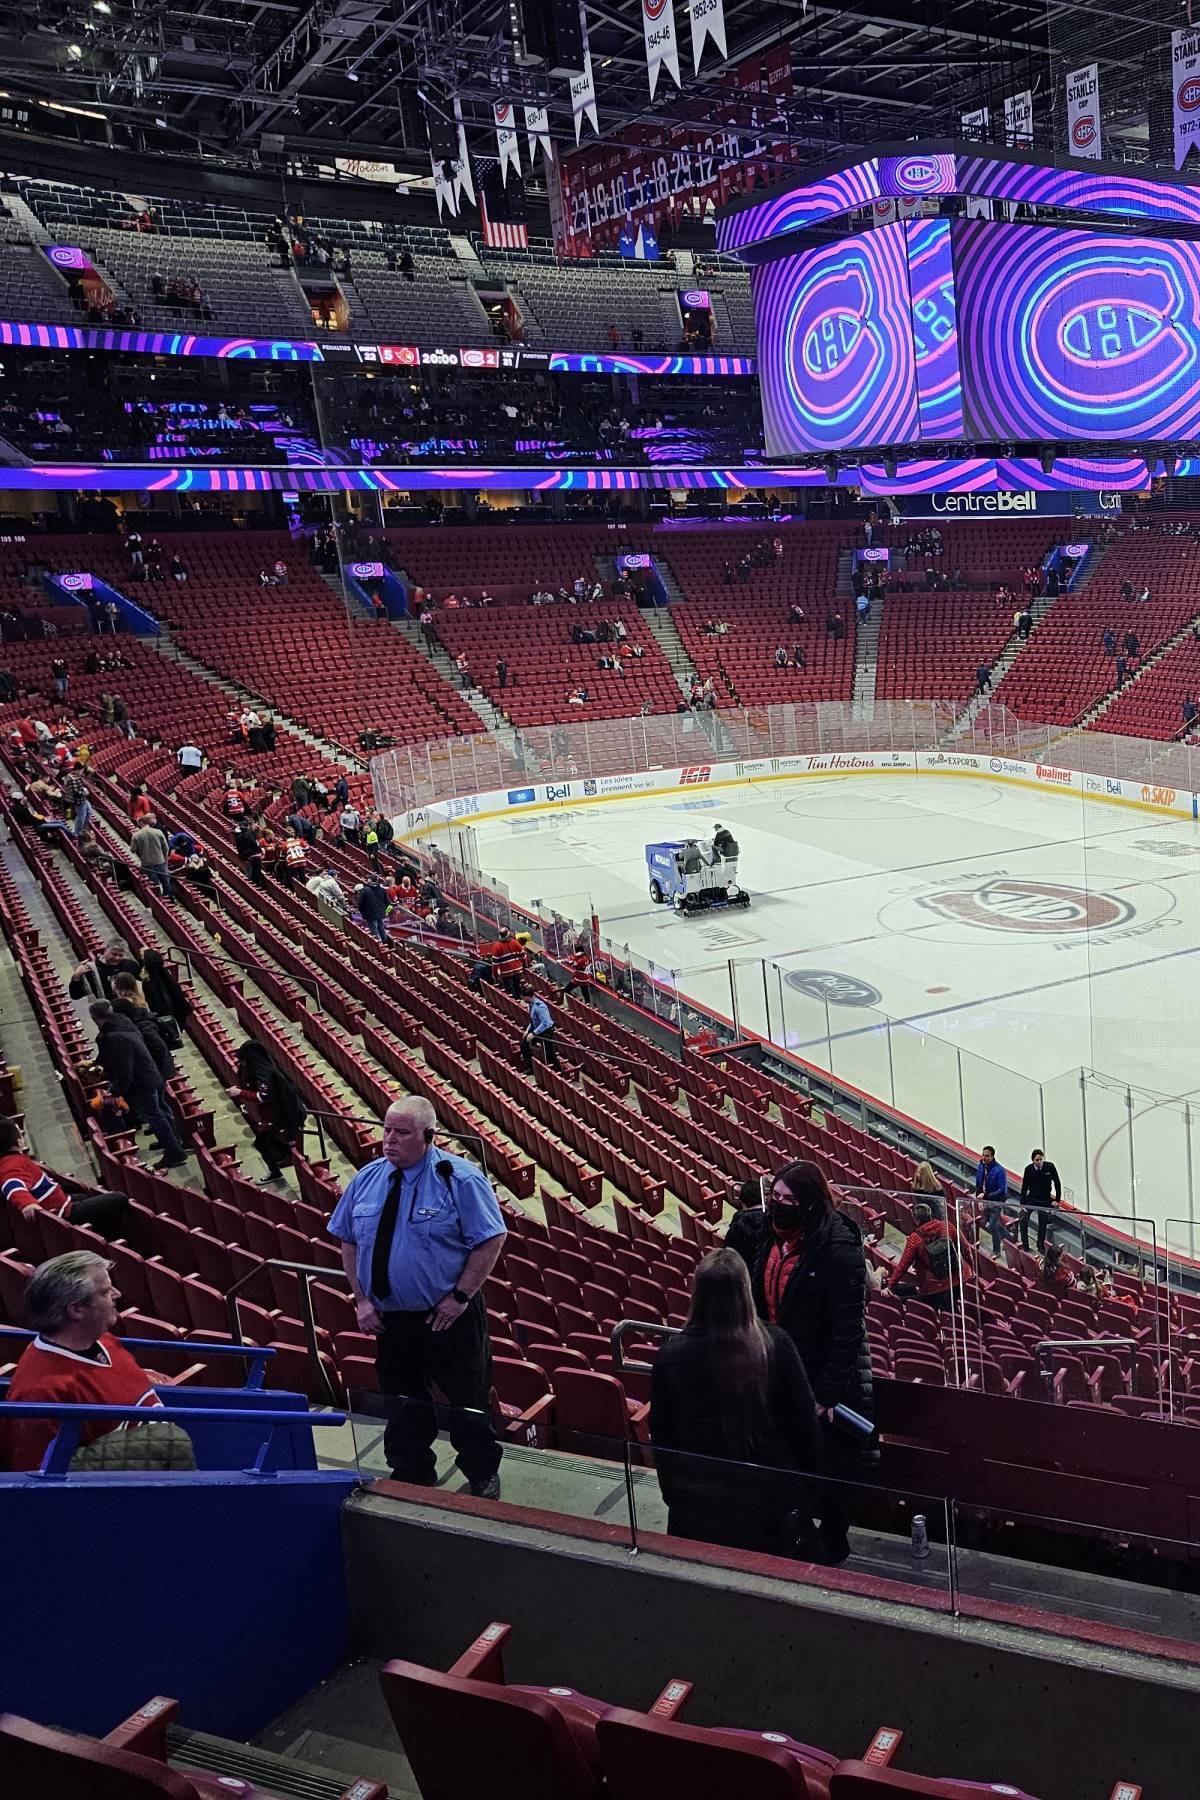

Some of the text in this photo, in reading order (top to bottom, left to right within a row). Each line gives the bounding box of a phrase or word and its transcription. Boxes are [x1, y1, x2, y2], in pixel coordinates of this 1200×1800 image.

[647, 25, 671, 49] 1945-46
[1186, 58, 1197, 69] CUP
[1073, 70, 1090, 83] COUPE
[1068, 78, 1096, 102] STANLEY
[1079, 100, 1088, 109] CUP
[383, 349, 393, 360] 5
[422, 353, 458, 365] 20:00
[486, 353, 496, 364] 2
[806, 755, 874, 770] Tim Hortons
[679, 766, 712, 784] IGA
[1036, 763, 1072, 783] Qualinet
[546, 784, 571, 799] Bell
[1106, 779, 1121, 795] Bell
[447, 796, 479, 817] IBM
[526, 1424, 537, 1441] M
